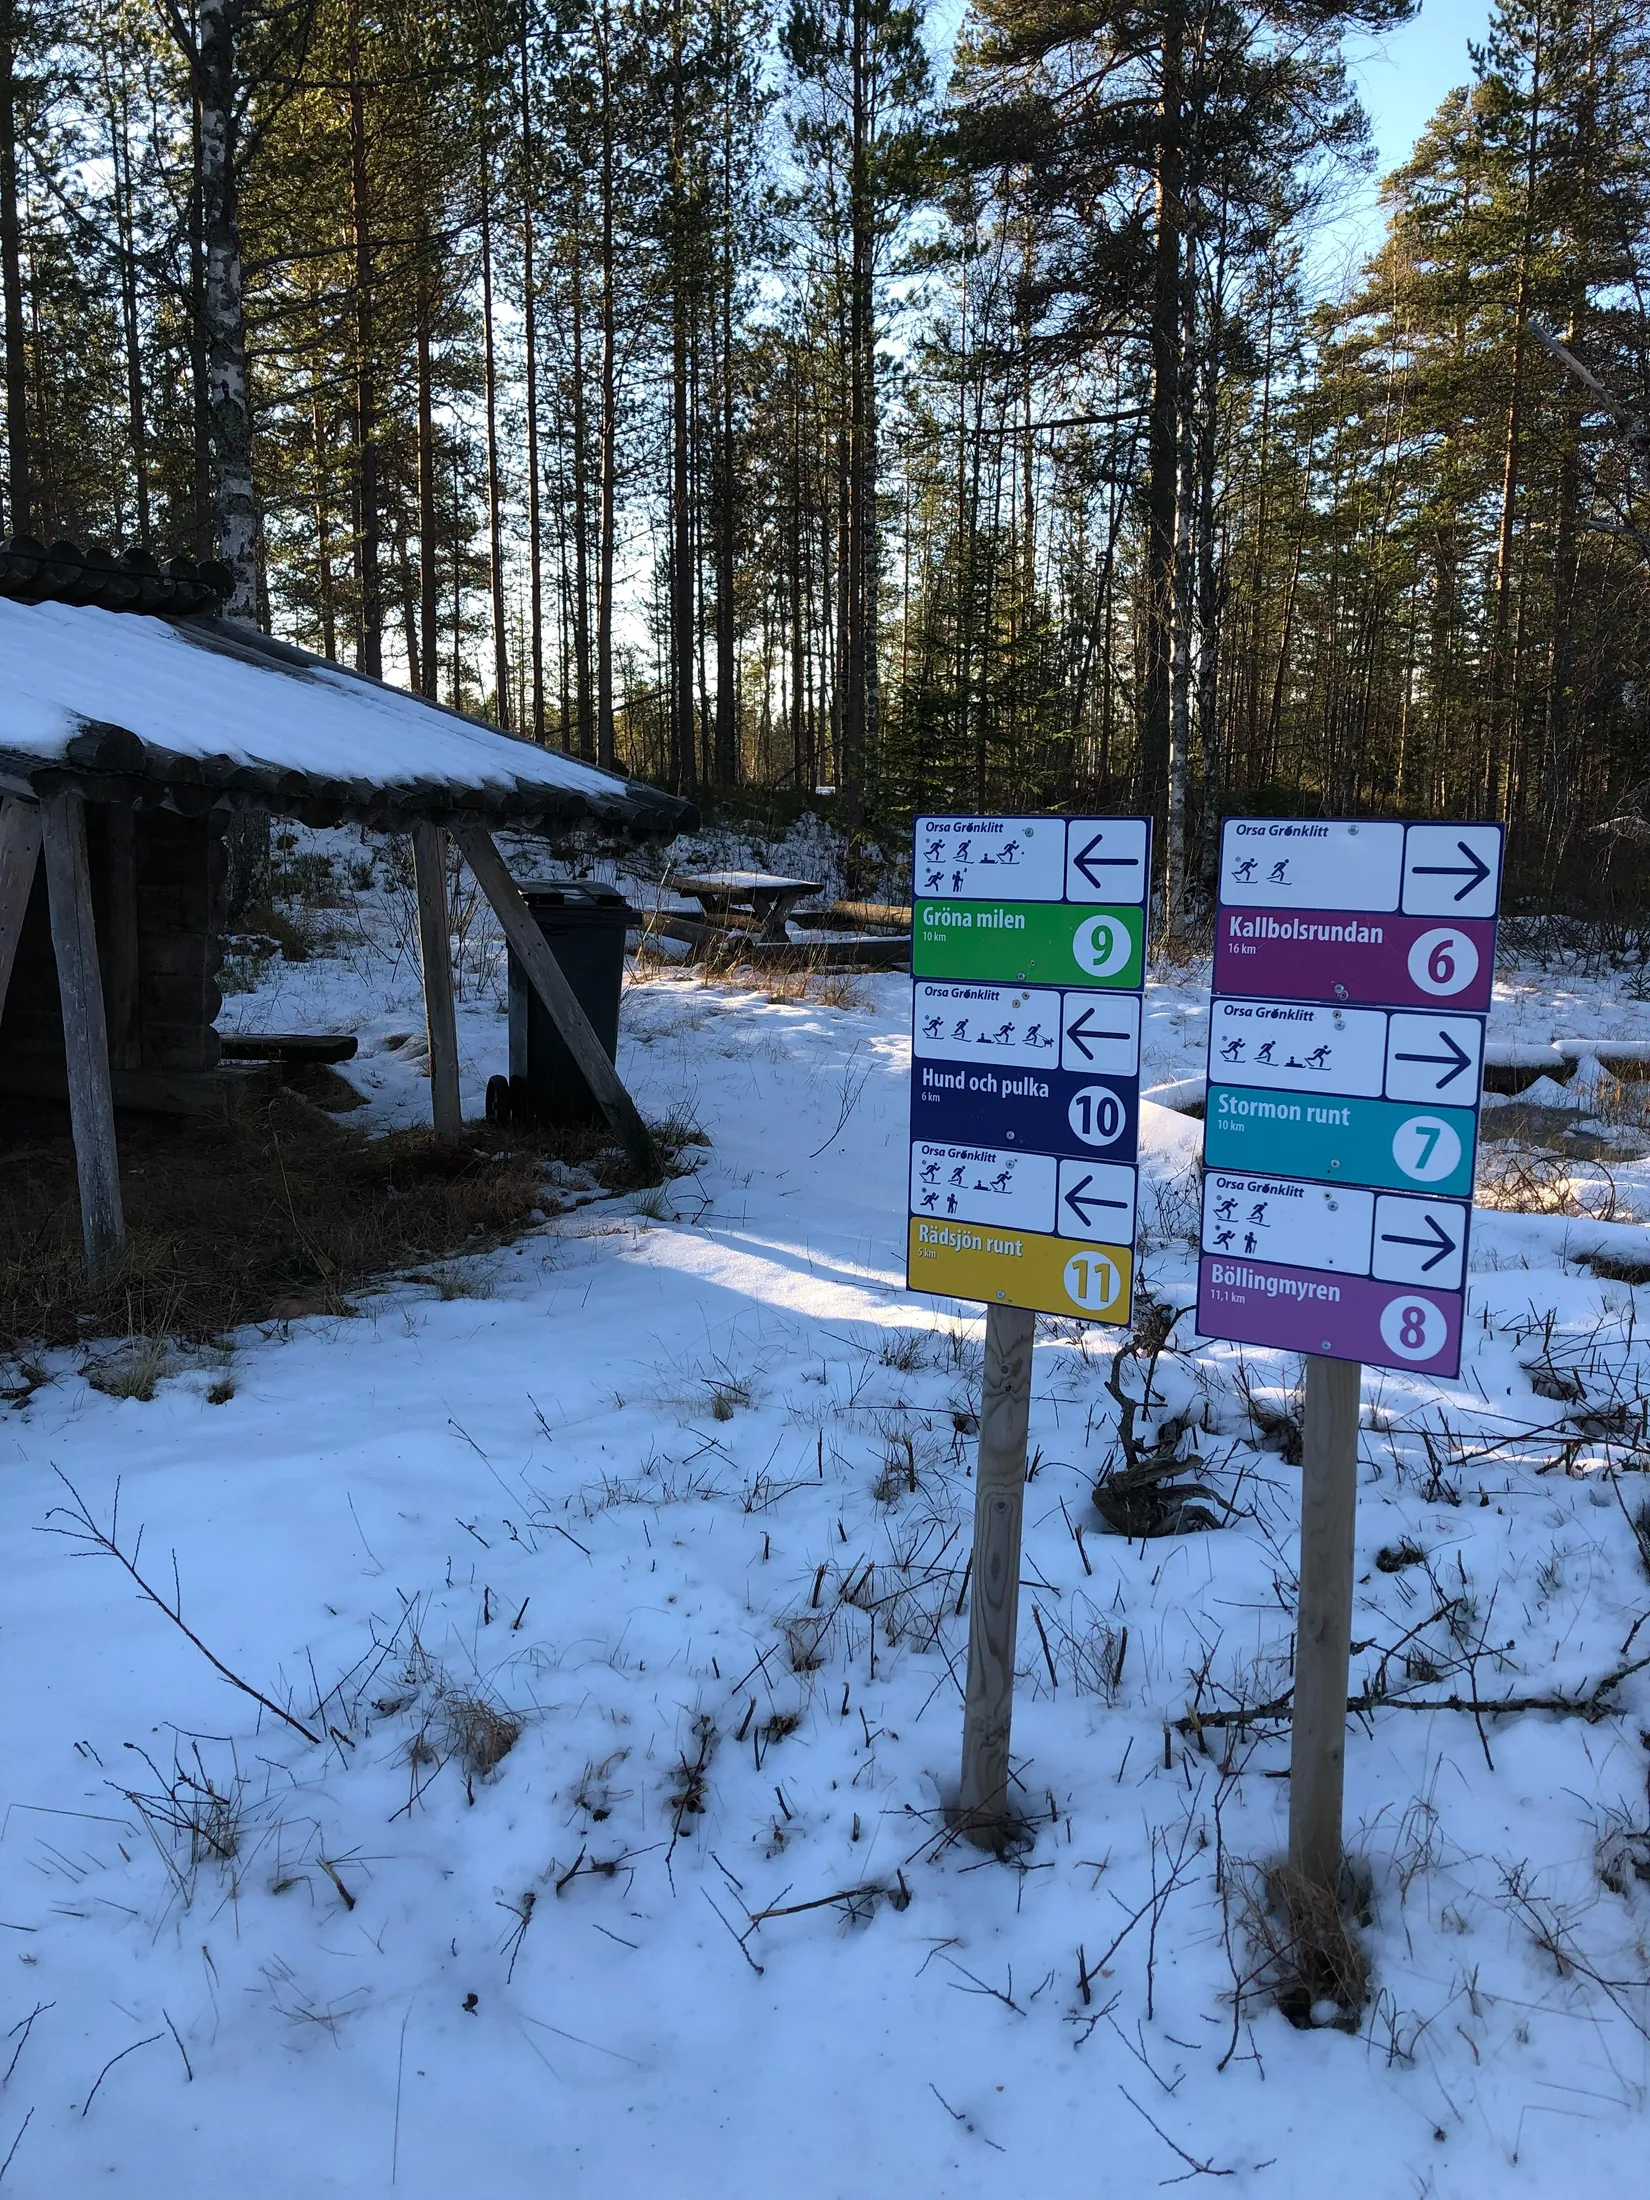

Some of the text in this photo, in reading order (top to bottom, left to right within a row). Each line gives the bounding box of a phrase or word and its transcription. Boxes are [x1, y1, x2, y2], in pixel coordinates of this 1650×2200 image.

[926, 822, 950, 833] Orsa
[1236, 824, 1266, 836] Orsa
[923, 907, 1025, 929] Gröna milen
[923, 932, 946, 942] 10 km
[1230, 916, 1383, 944] Kallbolsrundan
[1091, 925, 1113, 966] 9
[1228, 943, 1256, 955] 16 km
[1428, 939, 1454, 984] 6
[925, 987, 949, 998] Orsa
[1224, 1005, 1253, 1018] Orsa
[923, 1068, 1049, 1098] Hund och pulka
[921, 1093, 940, 1102] 6 km
[1075, 1095, 1119, 1137] 10
[1218, 1094, 1350, 1126] Stormon runt
[1218, 1120, 1244, 1132] 10 km
[921, 1145, 945, 1157] Orsa
[1414, 1126, 1440, 1169] 7
[1216, 1178, 1244, 1191] Orsa
[919, 1224, 1023, 1257] Rädsjön runt
[918, 1248, 937, 1259] 5 km
[1072, 1259, 1111, 1303] 11
[1212, 1264, 1341, 1302] Böllingmyren
[1210, 1290, 1246, 1304] 11,1 km
[1400, 1306, 1426, 1350] 8
